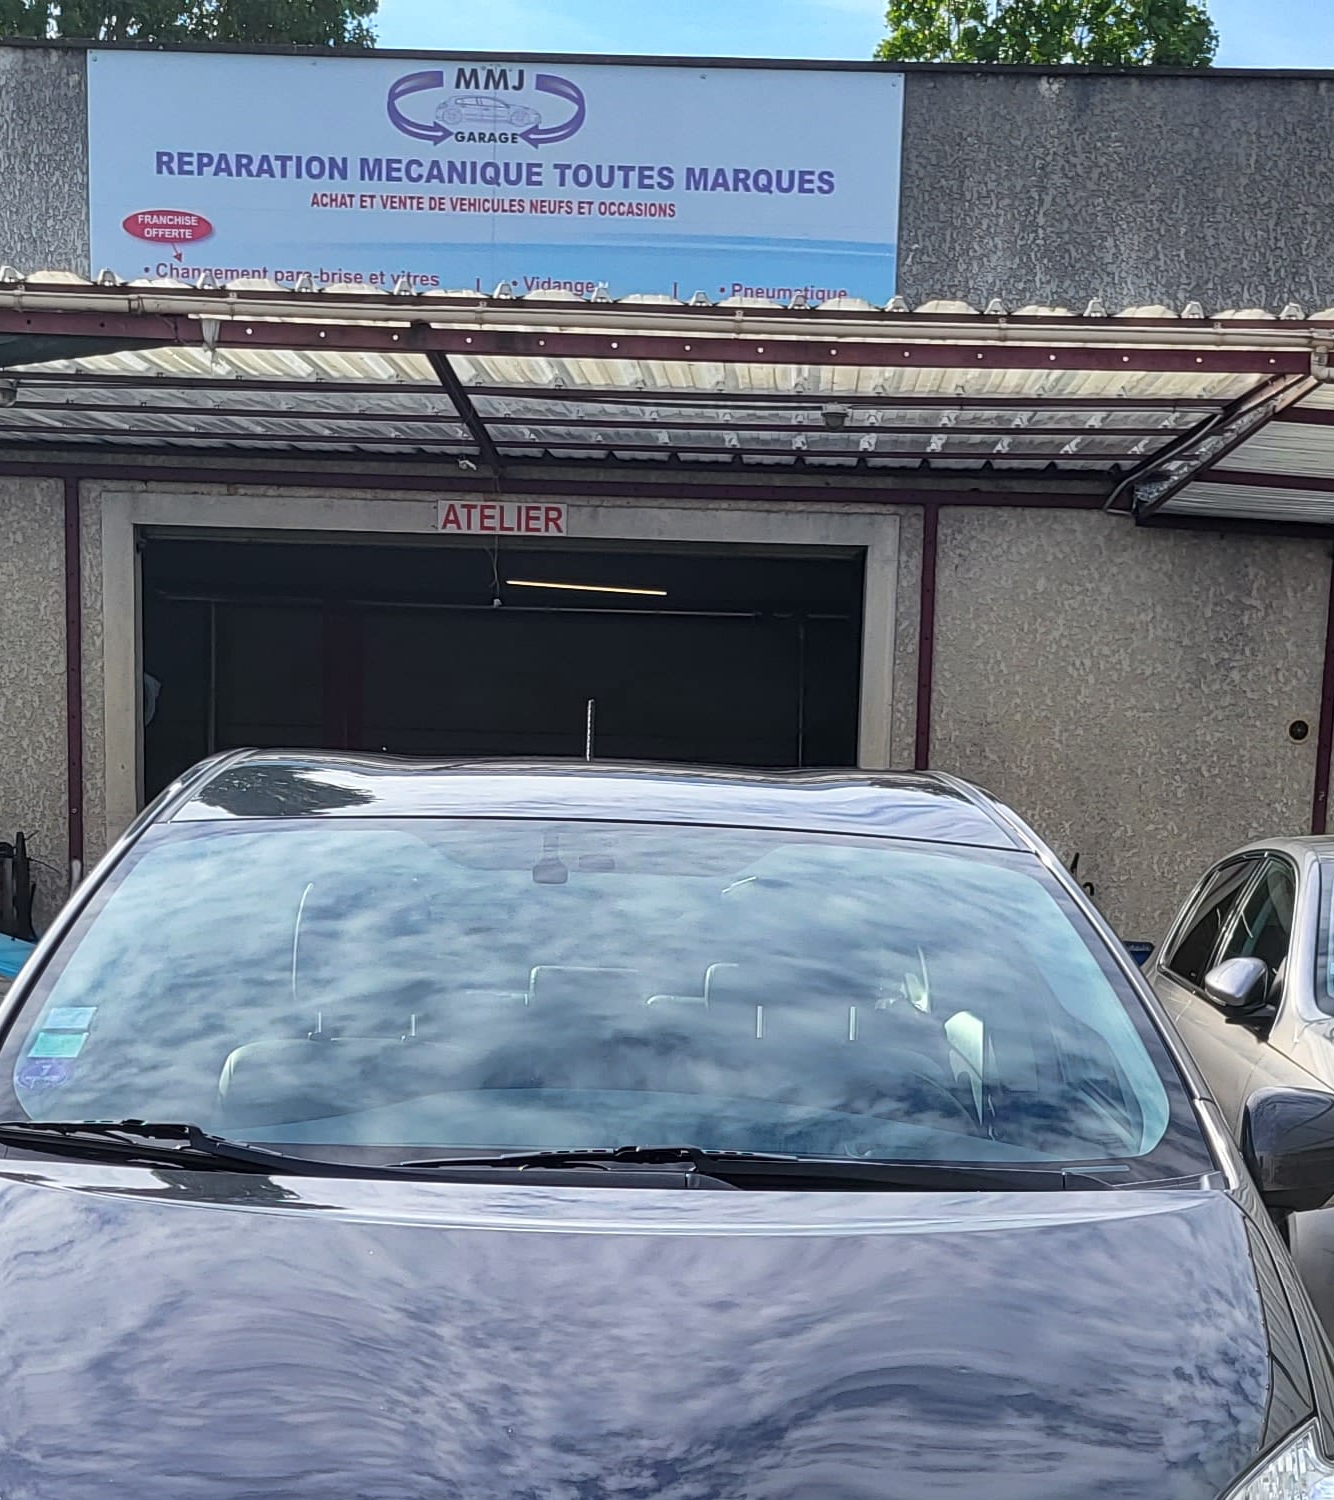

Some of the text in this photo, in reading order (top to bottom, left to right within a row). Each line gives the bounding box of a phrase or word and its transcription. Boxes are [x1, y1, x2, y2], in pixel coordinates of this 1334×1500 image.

[455, 67, 524, 91] MMJ
[454, 131, 519, 144] GARAGE
[155, 151, 835, 195] REPARATION MECANIQUE TOUTES MARQUES
[311, 193, 676, 218] ACHAT ET VENTE DE VEHICULES NEUFS ET OCCASIONS
[137, 214, 198, 226] FRANCHISE
[144, 227, 192, 239] OFFERTE
[369, 271, 386, 285] et
[441, 503, 563, 533] ATELIER
